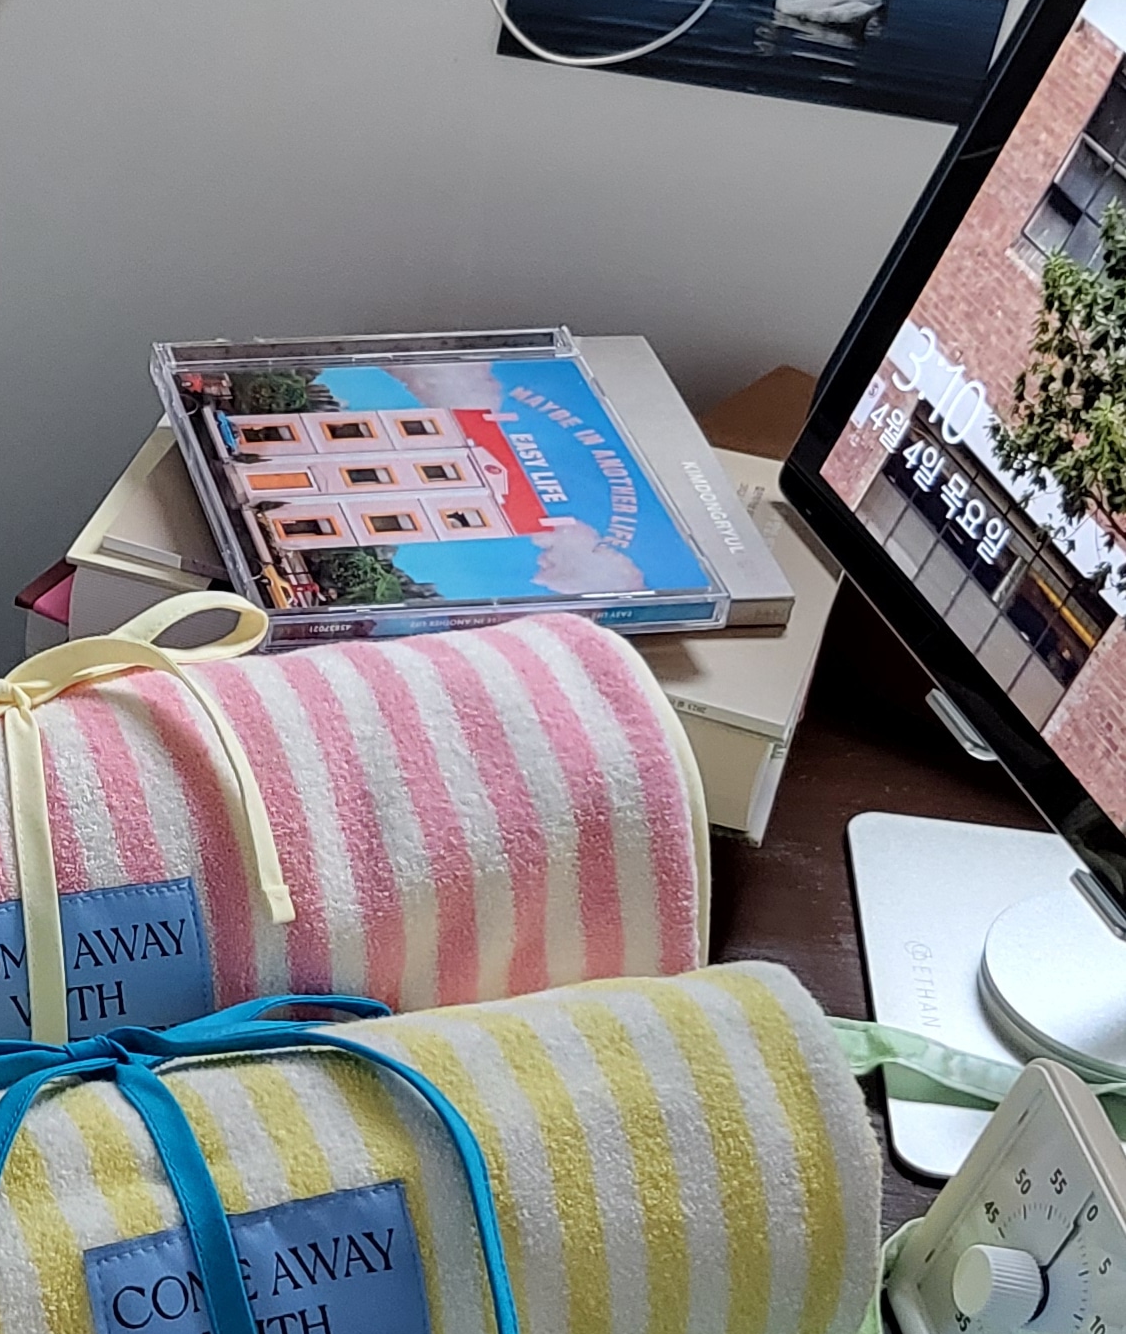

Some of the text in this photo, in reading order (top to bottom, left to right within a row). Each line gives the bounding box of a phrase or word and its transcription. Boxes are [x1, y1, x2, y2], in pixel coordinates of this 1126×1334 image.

[891, 326, 986, 445] 3:10
[508, 433, 570, 503] EASY LIFE
[509, 386, 584, 429] MAYBE
[573, 429, 606, 445] IN
[591, 449, 638, 514] ANOTHER
[681, 461, 745, 555] KIMDONGRYUL
[870, 402, 1011, 566] 4월 4일 목요일
[73, 918, 186, 970] AWAY
[1015, 1168, 1032, 1195] 50
[1049, 1168, 1068, 1195] 55
[984, 1201, 1000, 1224] 45
[1086, 1204, 1099, 1222] 0
[271, 1228, 394, 1297] AWAY
[1098, 1257, 1112, 1275] 5
[955, 1310, 971, 1332] 35
